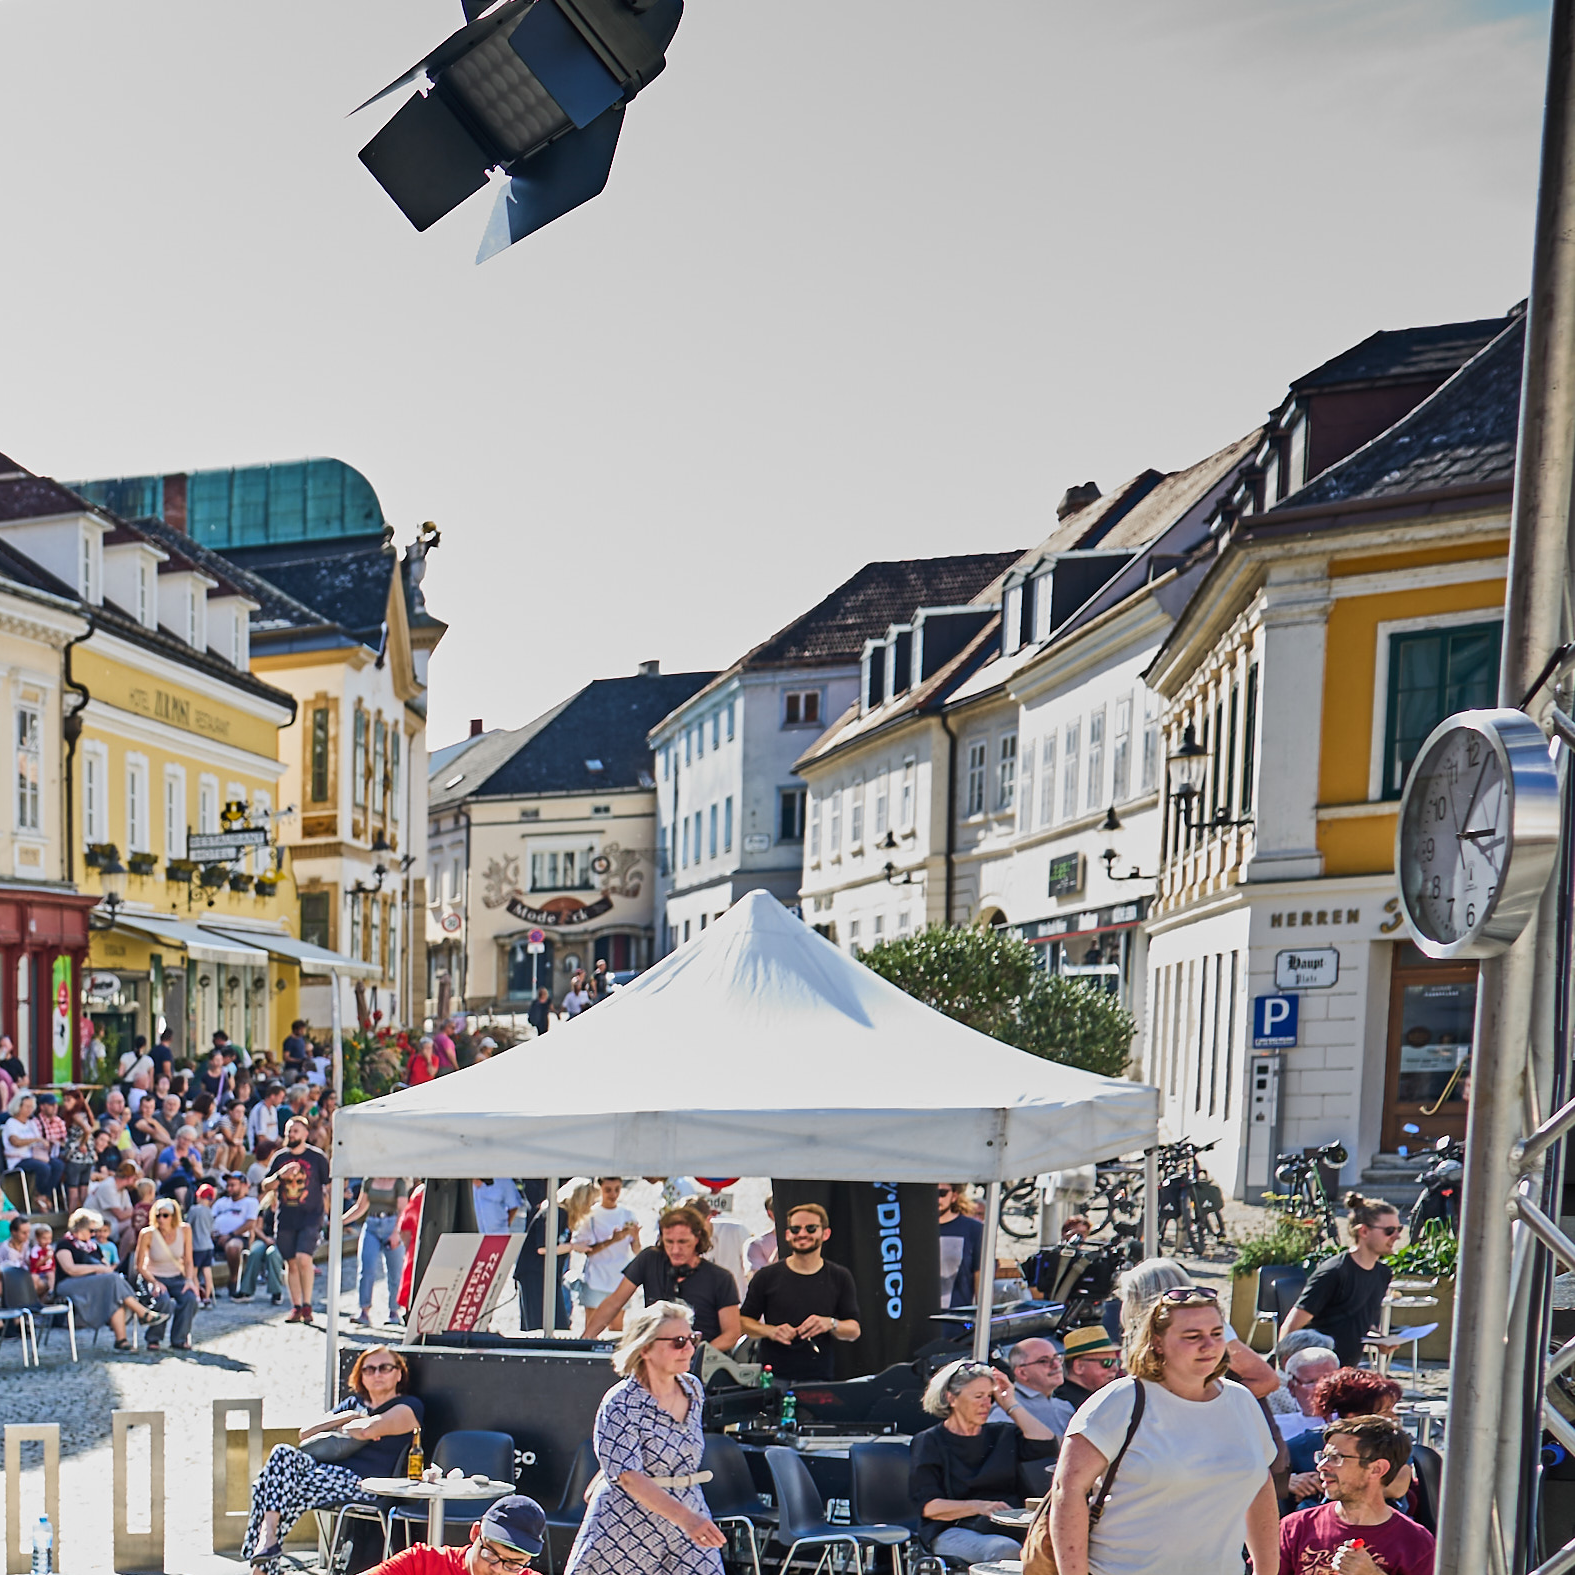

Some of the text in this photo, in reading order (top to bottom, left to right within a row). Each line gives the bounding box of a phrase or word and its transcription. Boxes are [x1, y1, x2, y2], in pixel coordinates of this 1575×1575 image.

[1466, 741, 1480, 769] 12
[1430, 795, 1447, 821] 10
[1426, 837, 1435, 862] 9
[1432, 874, 1441, 900] 8
[512, 903, 557, 924] Mode
[1270, 908, 1360, 928] HERREN
[1466, 902, 1475, 928] 6
[1263, 998, 1290, 1035] P
[481, 1252, 499, 1281] 722
